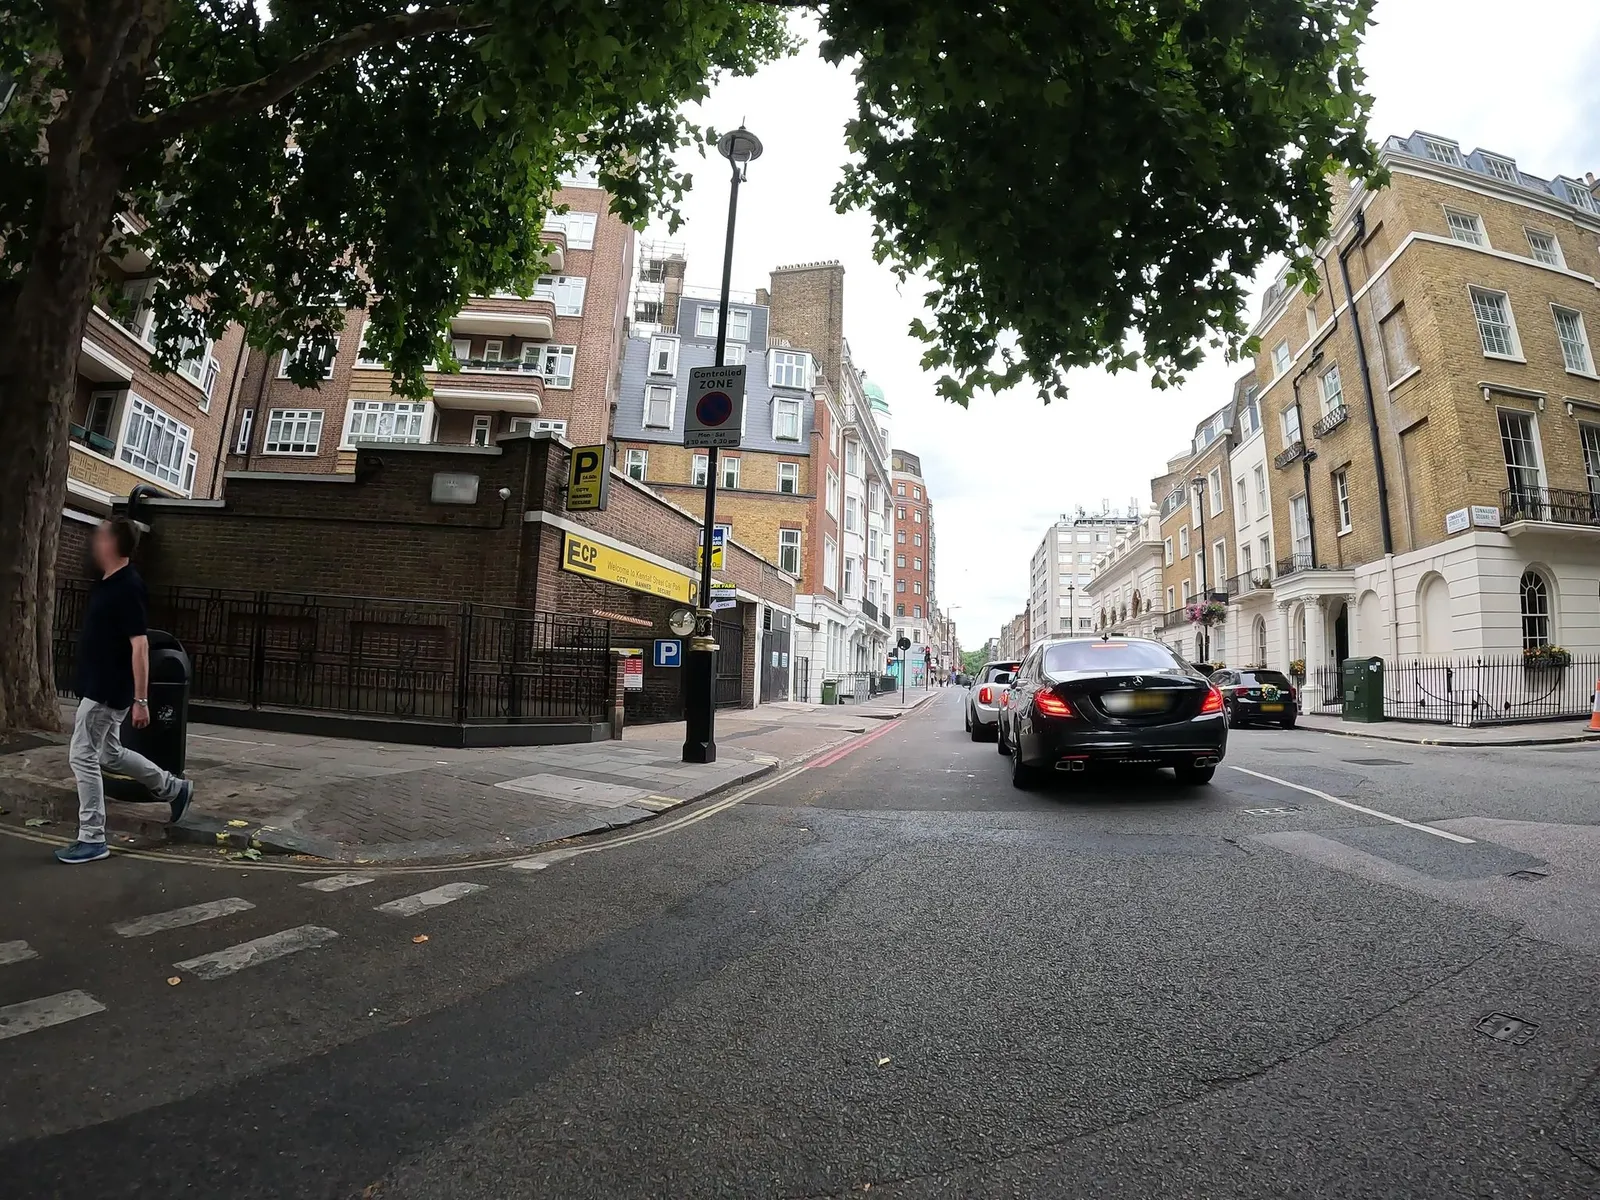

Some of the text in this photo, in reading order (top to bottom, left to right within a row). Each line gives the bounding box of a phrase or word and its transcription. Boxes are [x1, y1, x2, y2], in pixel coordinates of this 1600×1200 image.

[693, 369, 742, 378] Controlled
[699, 379, 733, 389] ZONE
[574, 452, 598, 485] P
[567, 539, 597, 570] ECP
[607, 561, 630, 576] Welcome
[616, 575, 672, 596] CCTV MANNED SECURE
[660, 642, 678, 664] P
